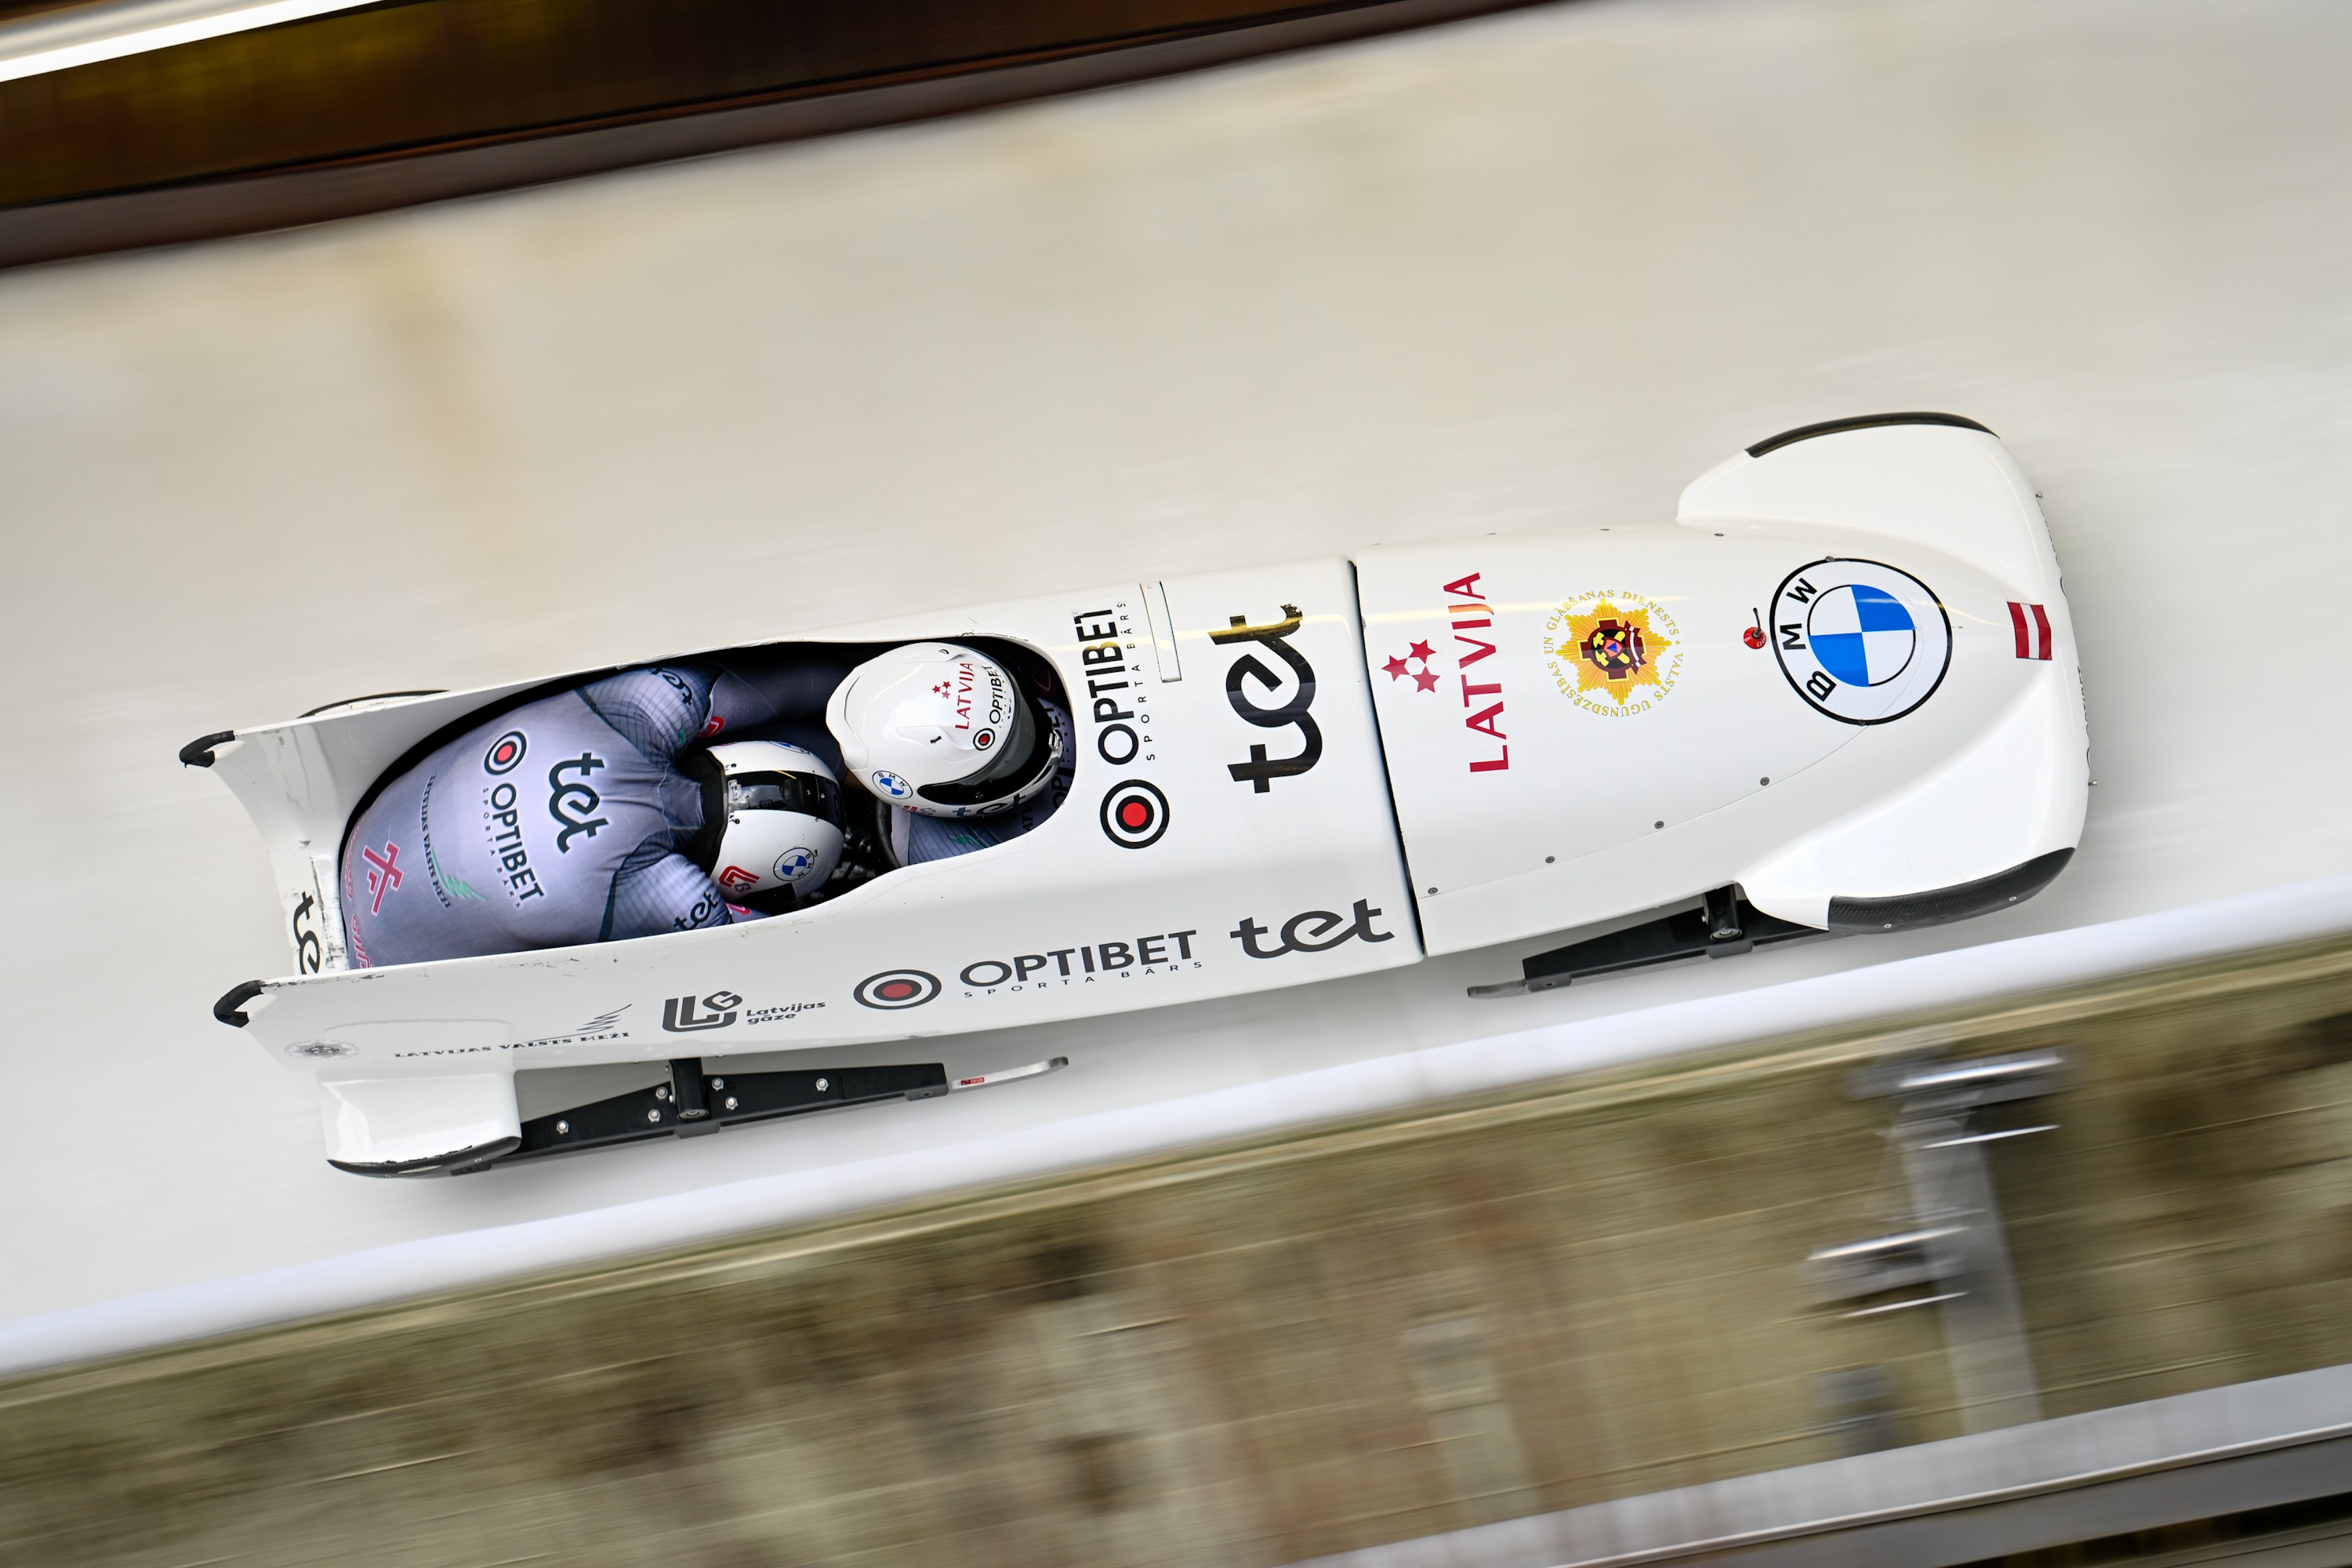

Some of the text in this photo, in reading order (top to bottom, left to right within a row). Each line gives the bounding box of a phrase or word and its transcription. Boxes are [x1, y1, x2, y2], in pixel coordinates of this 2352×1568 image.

[1546, 590, 1615, 631] GLĀBŠANAS
[1622, 590, 1679, 636] DIENESTS
[1779, 577, 1837, 702] BMW
[1443, 572, 1509, 773] LATVIJA
[1543, 636, 1554, 655] UN
[955, 662, 975, 730] LATVIJA
[981, 665, 1004, 724] OPTIBET
[1074, 608, 1139, 765] OPTIBET
[1116, 602, 1156, 761] SPORTA BĀRS
[1207, 602, 1323, 794] tet
[1653, 652, 1684, 702] VALSTS
[549, 752, 610, 855] tet
[877, 771, 907, 787] BMW
[483, 787, 496, 857] SPORTA
[492, 782, 545, 902] OPTIBET
[797, 852, 813, 879] BMW
[1229, 898, 1396, 960] tet
[959, 930, 1198, 988] OPTIBET
[964, 960, 1203, 999] SPORTA BĀRS
[746, 1002, 826, 1017] Latvijas
[747, 1012, 797, 1025] gāze
[394, 1045, 492, 1058] LATVIJAS
[498, 1038, 572, 1050] VALSTS
